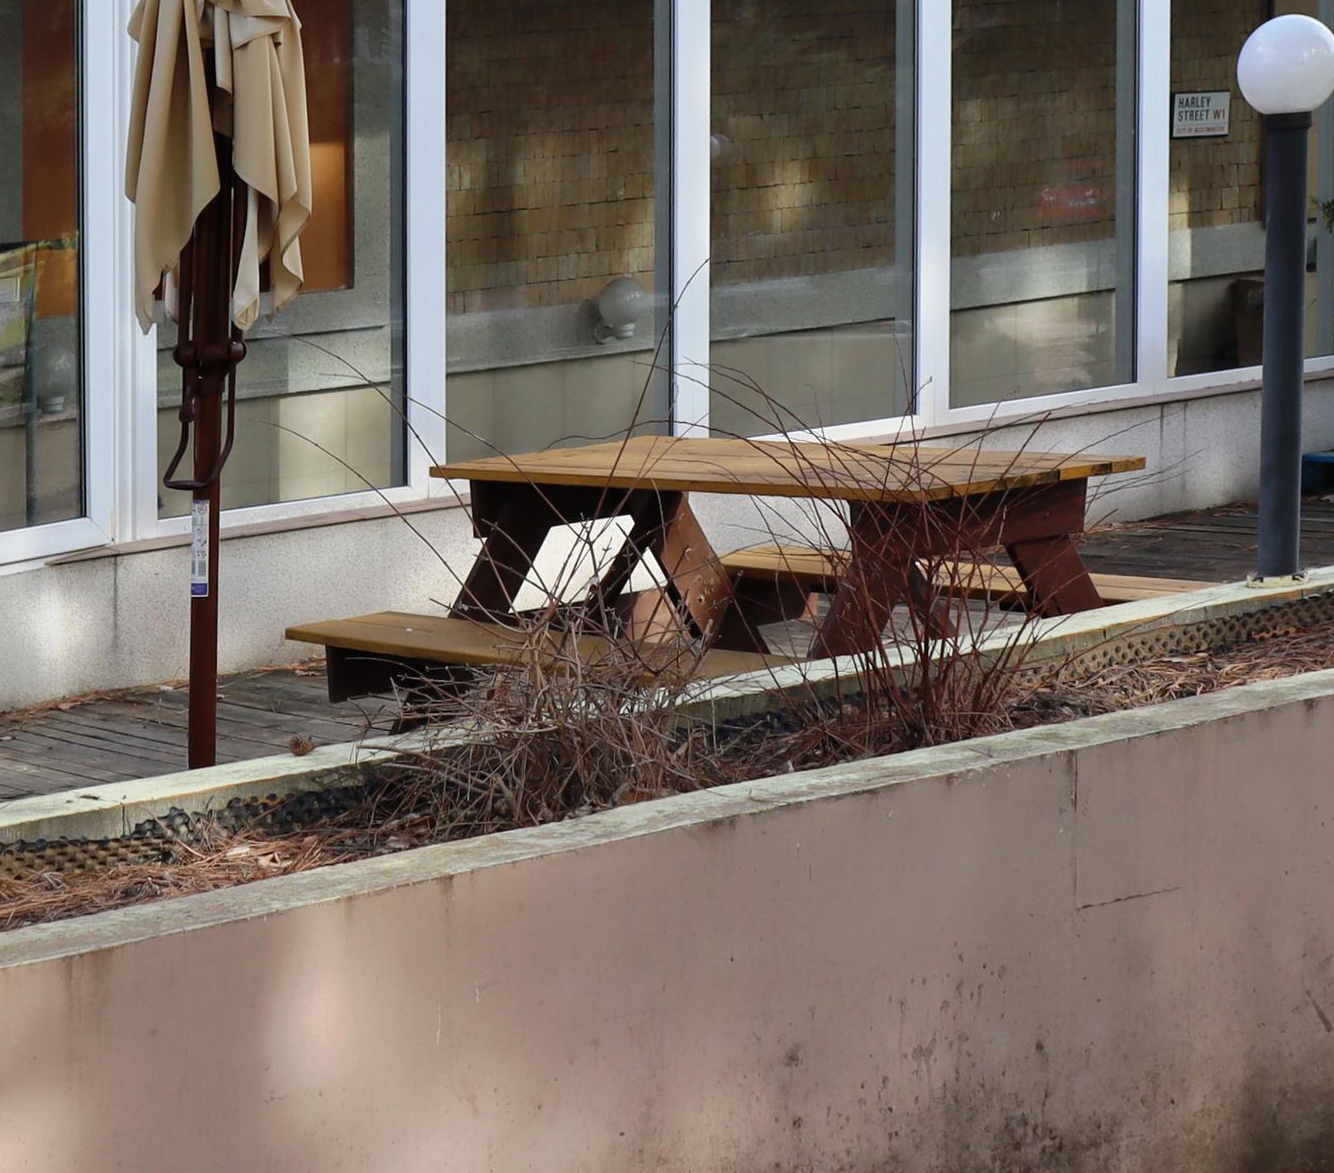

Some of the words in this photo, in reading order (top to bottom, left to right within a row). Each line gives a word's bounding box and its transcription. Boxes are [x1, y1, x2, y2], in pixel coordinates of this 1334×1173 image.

[1178, 96, 1212, 108] HARLEY
[1178, 109, 1210, 122] STREET
[1212, 109, 1226, 120] W1
